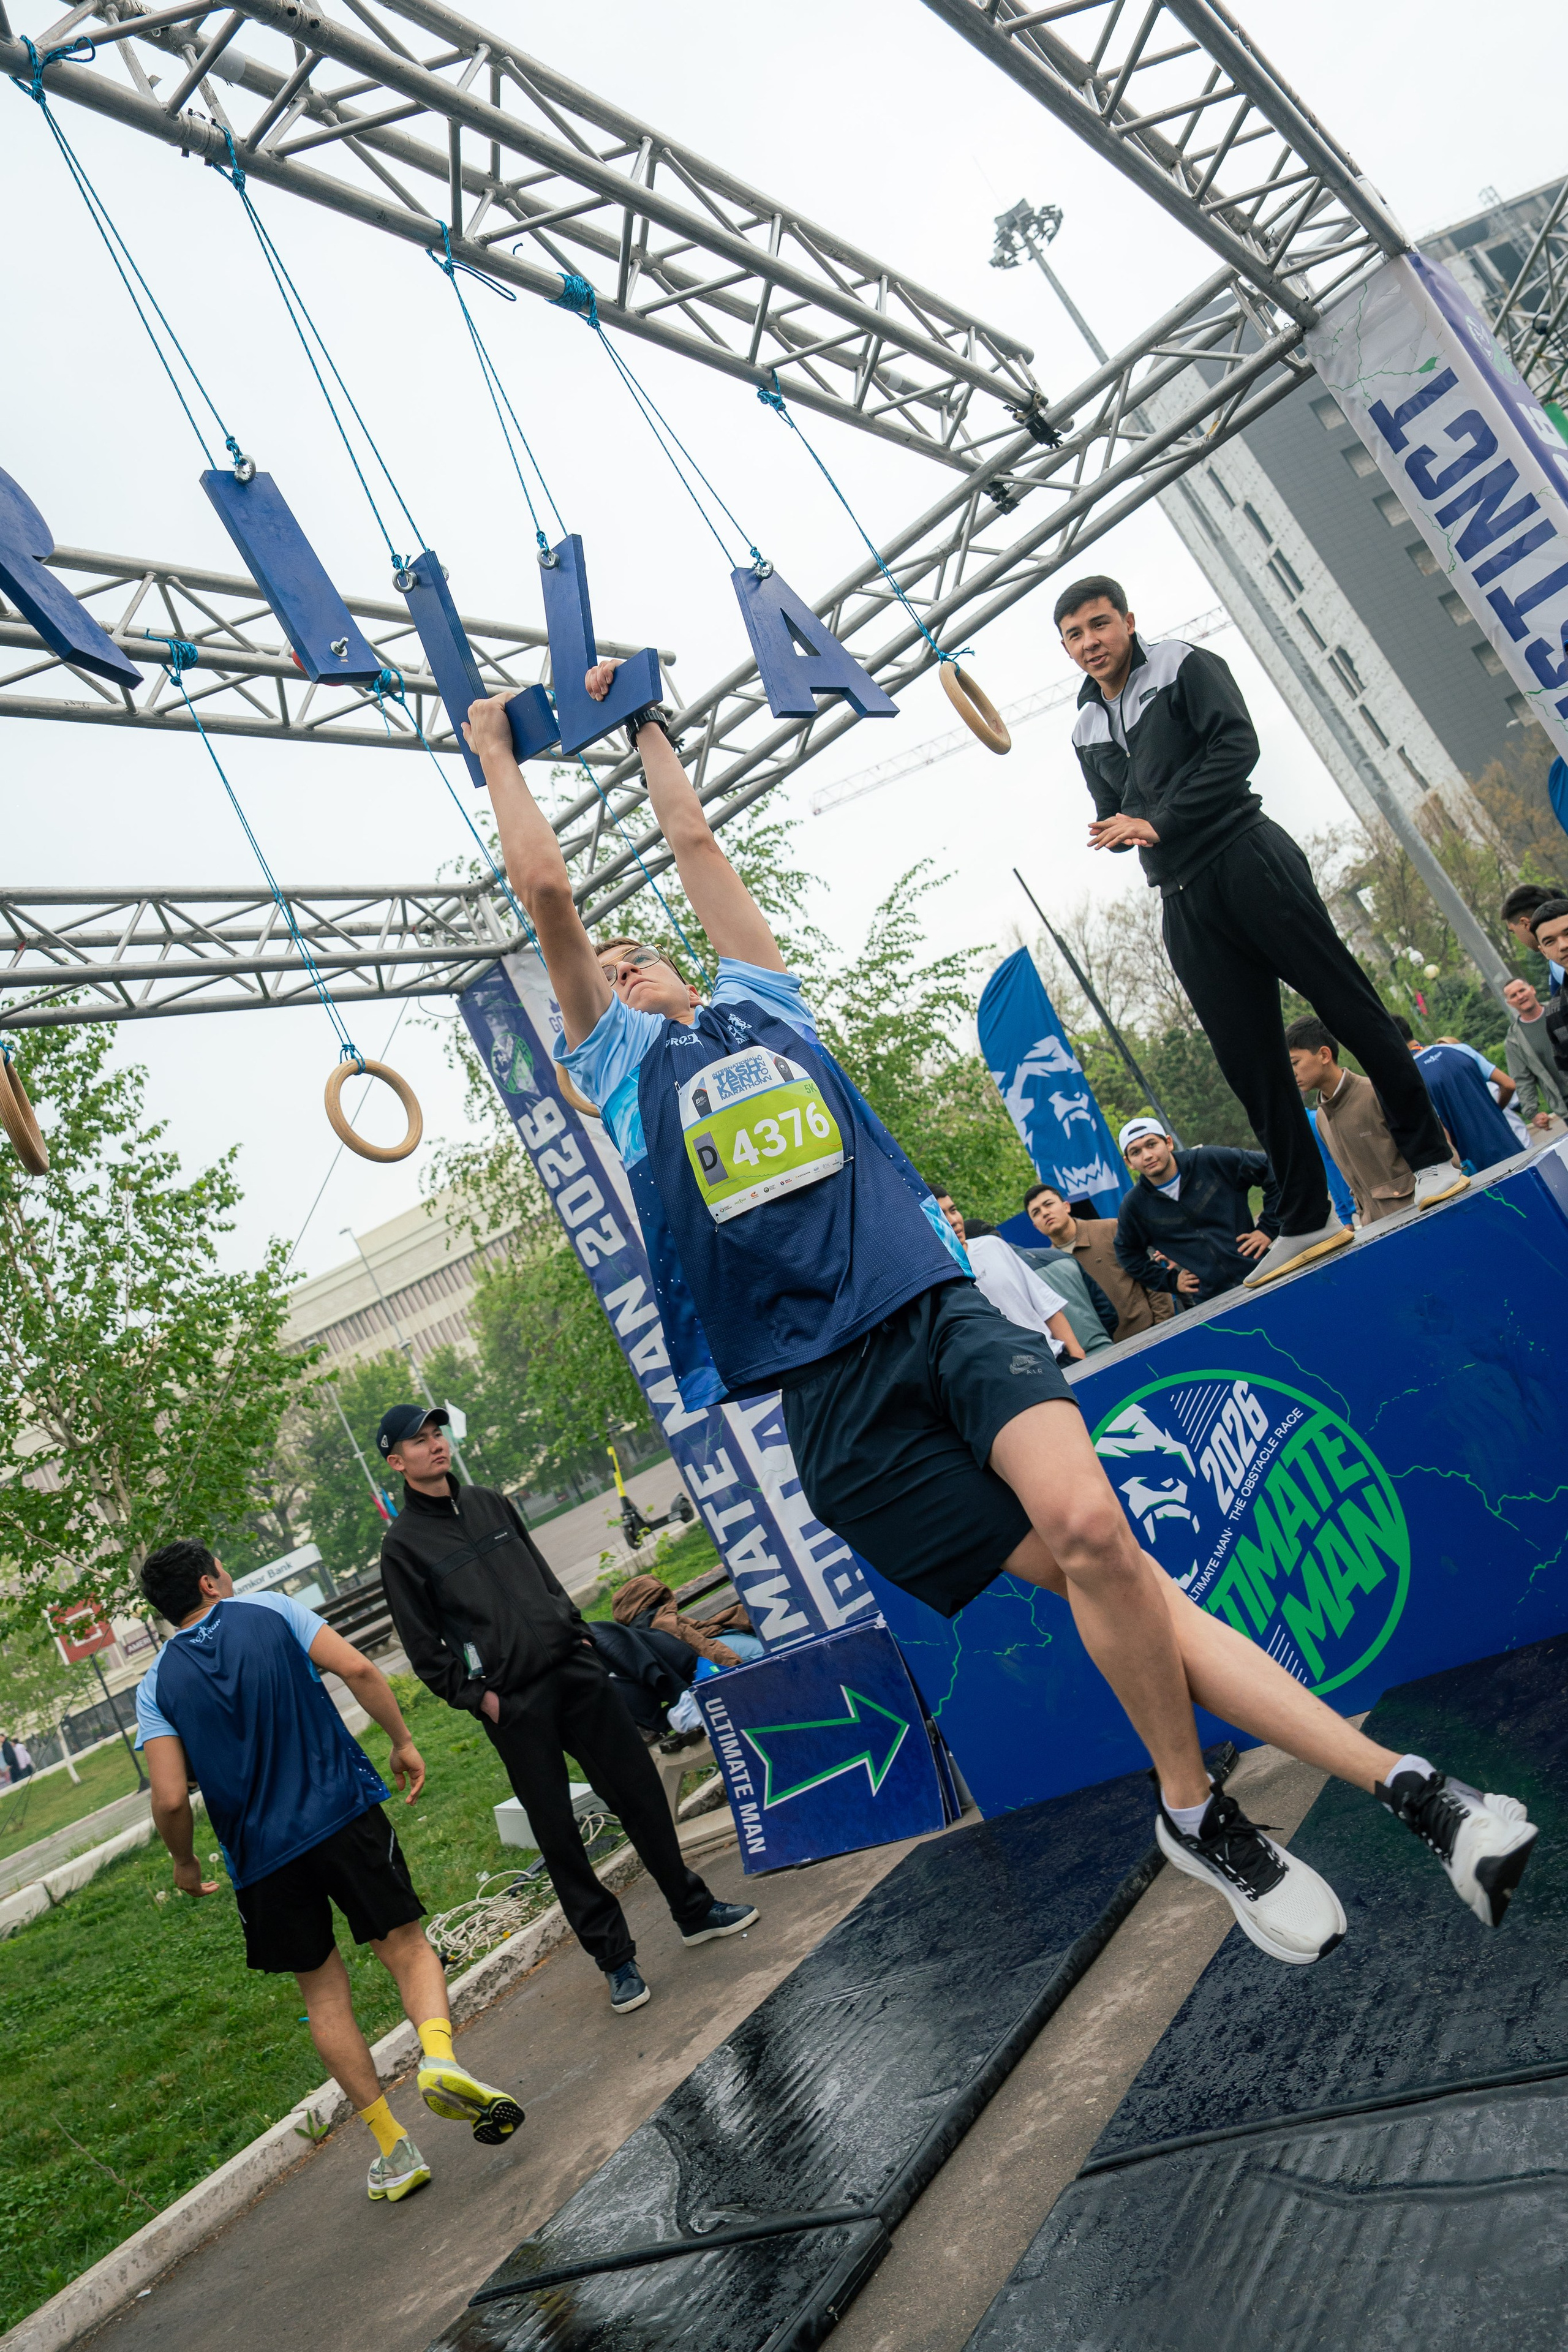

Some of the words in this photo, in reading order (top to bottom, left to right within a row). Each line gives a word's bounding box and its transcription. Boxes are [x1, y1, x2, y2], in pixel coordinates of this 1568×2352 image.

[712, 1057, 756, 1079] INTERNATIONAL
[713, 1058, 761, 1085] TASH
[717, 1069, 760, 1096] KENT
[733, 1102, 830, 1166] 4376
[804, 1084, 817, 1095] 5K
[518, 1096, 627, 1268] 2026
[697, 1145, 718, 1172] D
[603, 1275, 709, 1437] MAN
[1188, 1558, 1219, 1601] LTIMATE
[1229, 1498, 1246, 1521] THE
[1241, 1438, 1279, 1496] OBSTACLE
[1276, 1408, 1303, 1441] RACE
[1199, 1379, 1269, 1515] 2026
[233, 1575, 265, 1596] amkor
[266, 1561, 293, 1578] Bank
[684, 1447, 816, 1652] MATE
[1200, 1412, 1370, 1640] TIMATE
[1281, 1483, 1401, 1682] MAN
[705, 1697, 754, 1799] ULTIMATE
[739, 1801, 766, 1854] MAN
